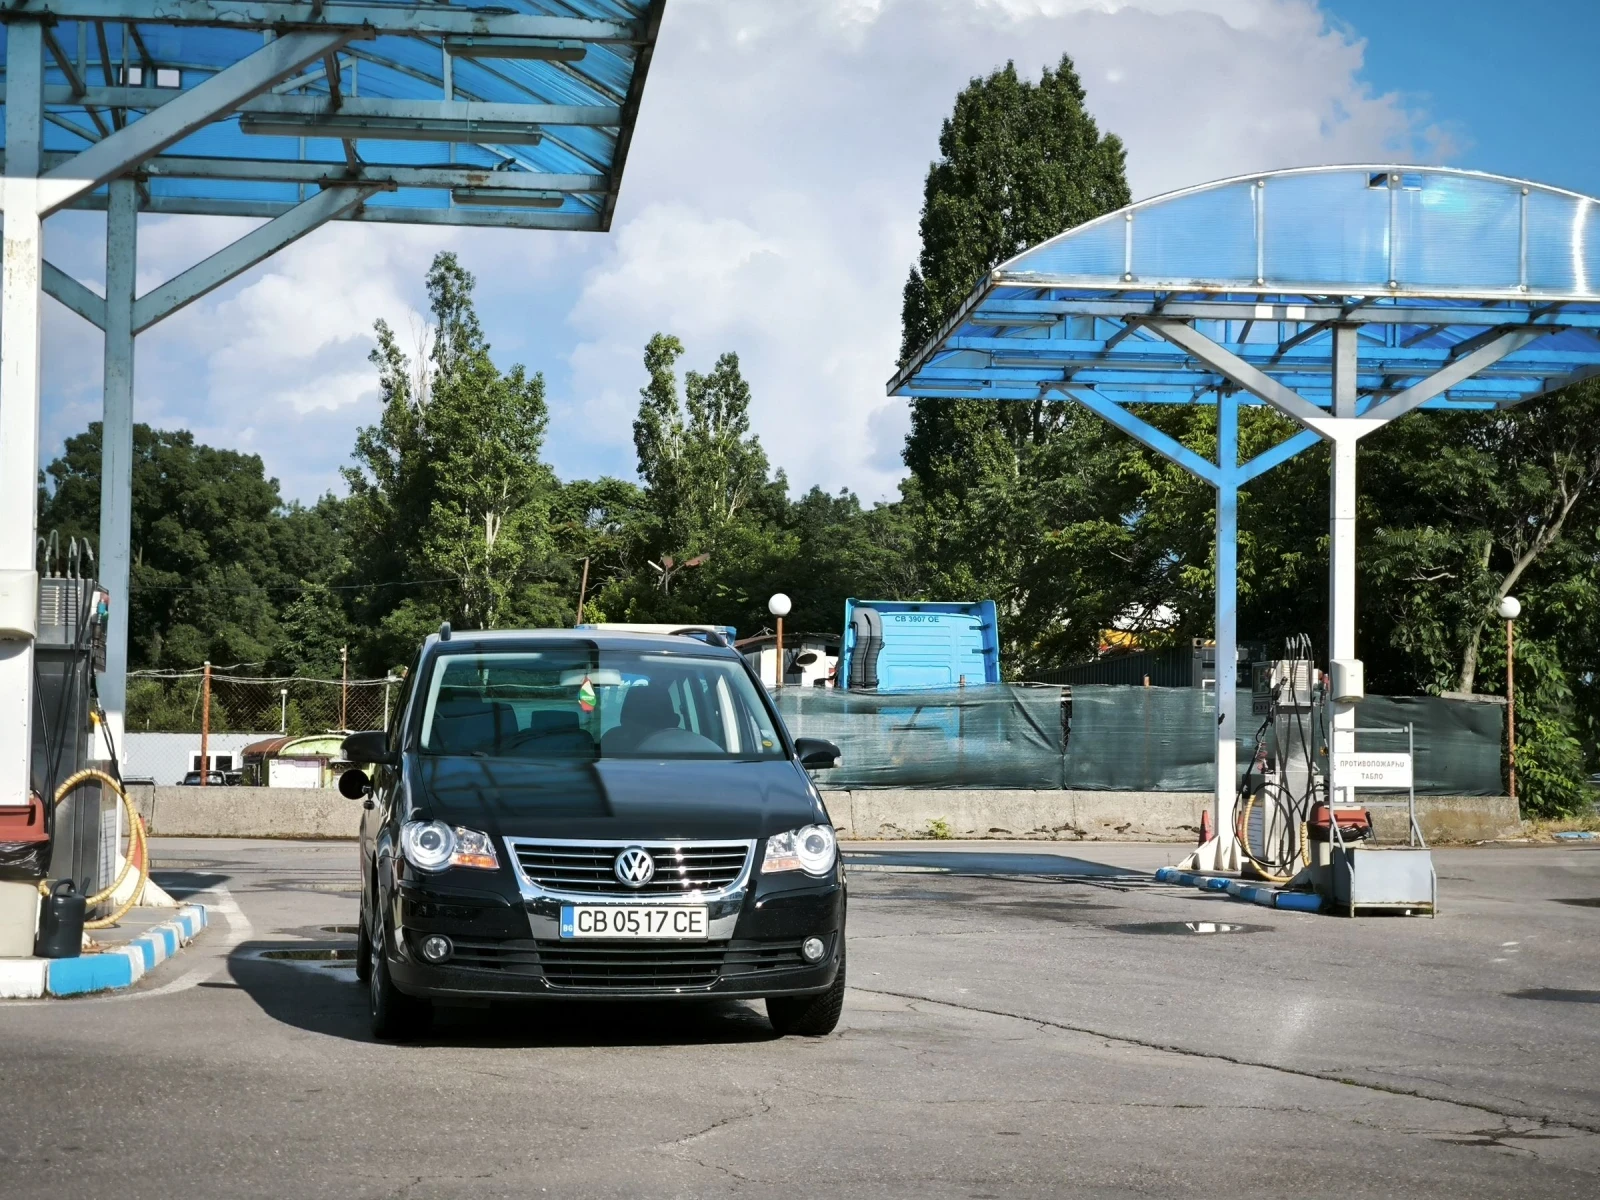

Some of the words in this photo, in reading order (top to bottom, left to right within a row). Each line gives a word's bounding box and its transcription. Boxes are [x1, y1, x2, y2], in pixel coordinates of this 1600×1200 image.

[908, 615, 926, 623] 3907
[578, 911, 607, 932] CB
[613, 911, 669, 933] 0517
[674, 911, 702, 932] CE
[563, 924, 573, 932] BG
